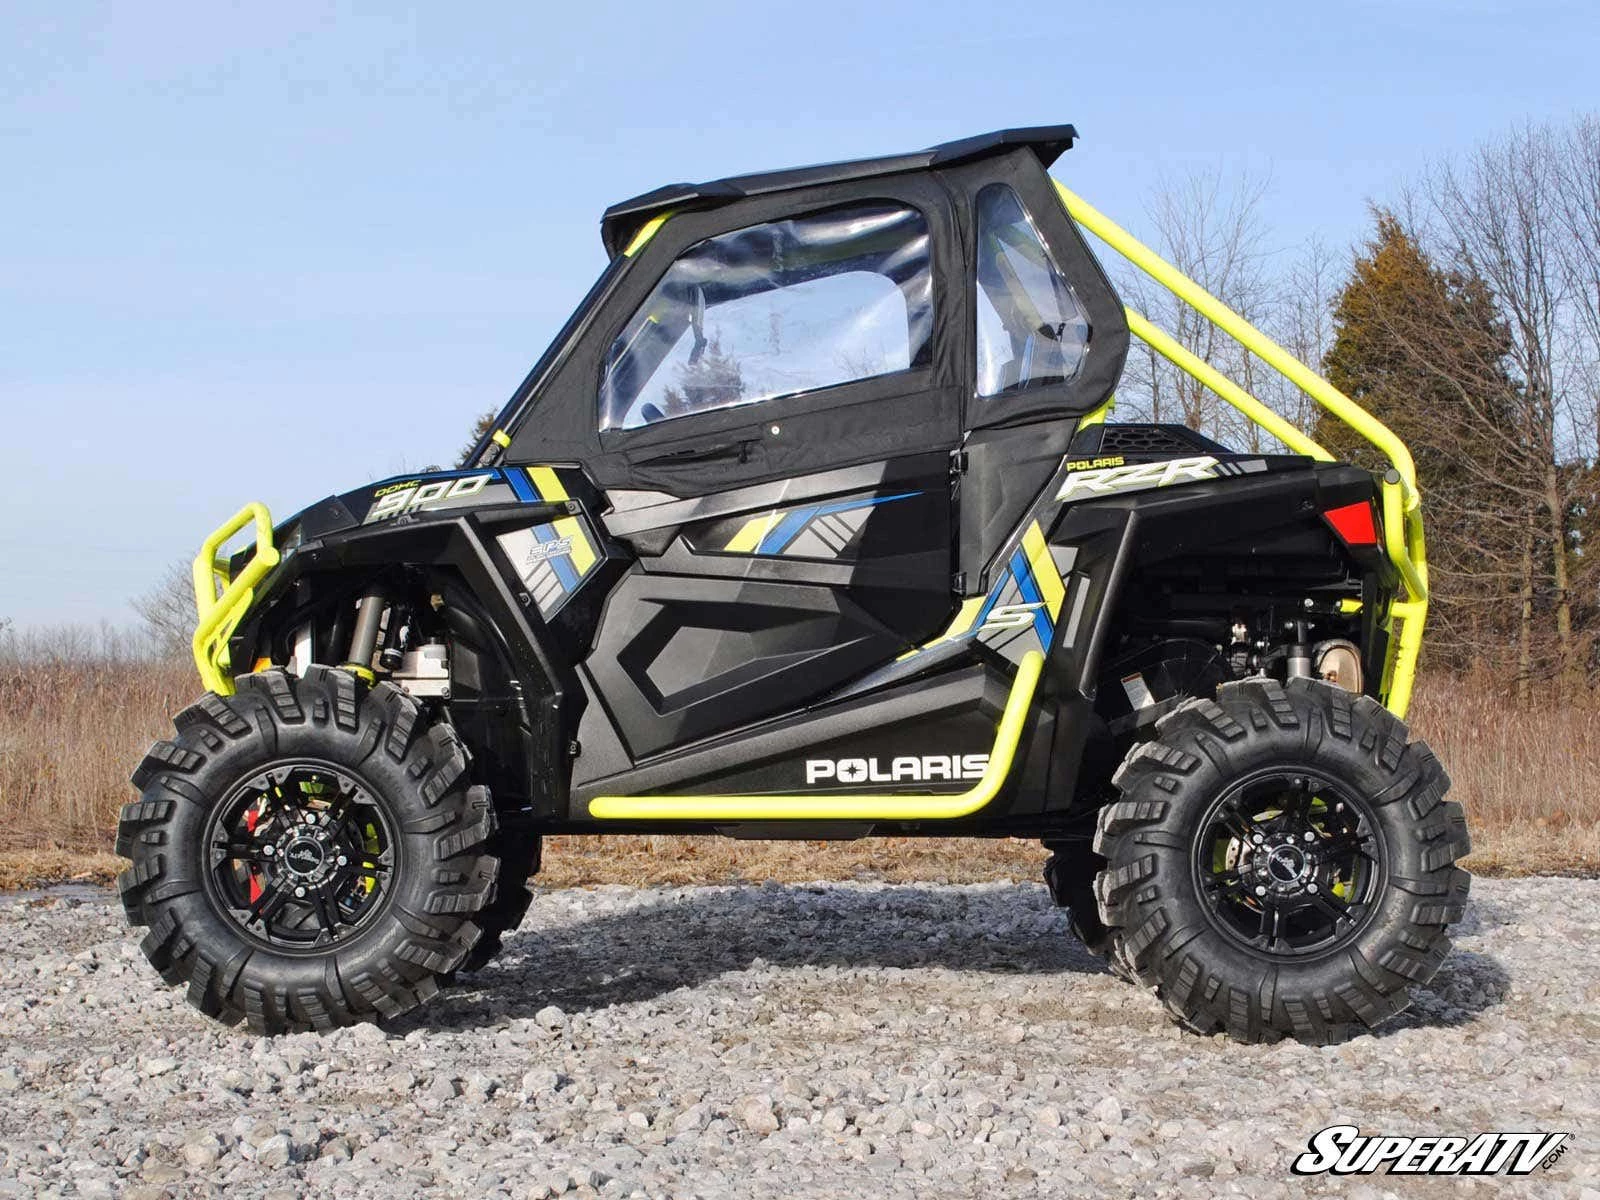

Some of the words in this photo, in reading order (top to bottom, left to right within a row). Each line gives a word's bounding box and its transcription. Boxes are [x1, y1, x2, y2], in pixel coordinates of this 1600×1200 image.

[1055, 455, 1221, 501] RZR
[1066, 456, 1125, 472] POLARIS
[371, 474, 492, 520] 900
[374, 479, 421, 498] DOHC
[806, 754, 990, 784] POLARIS
